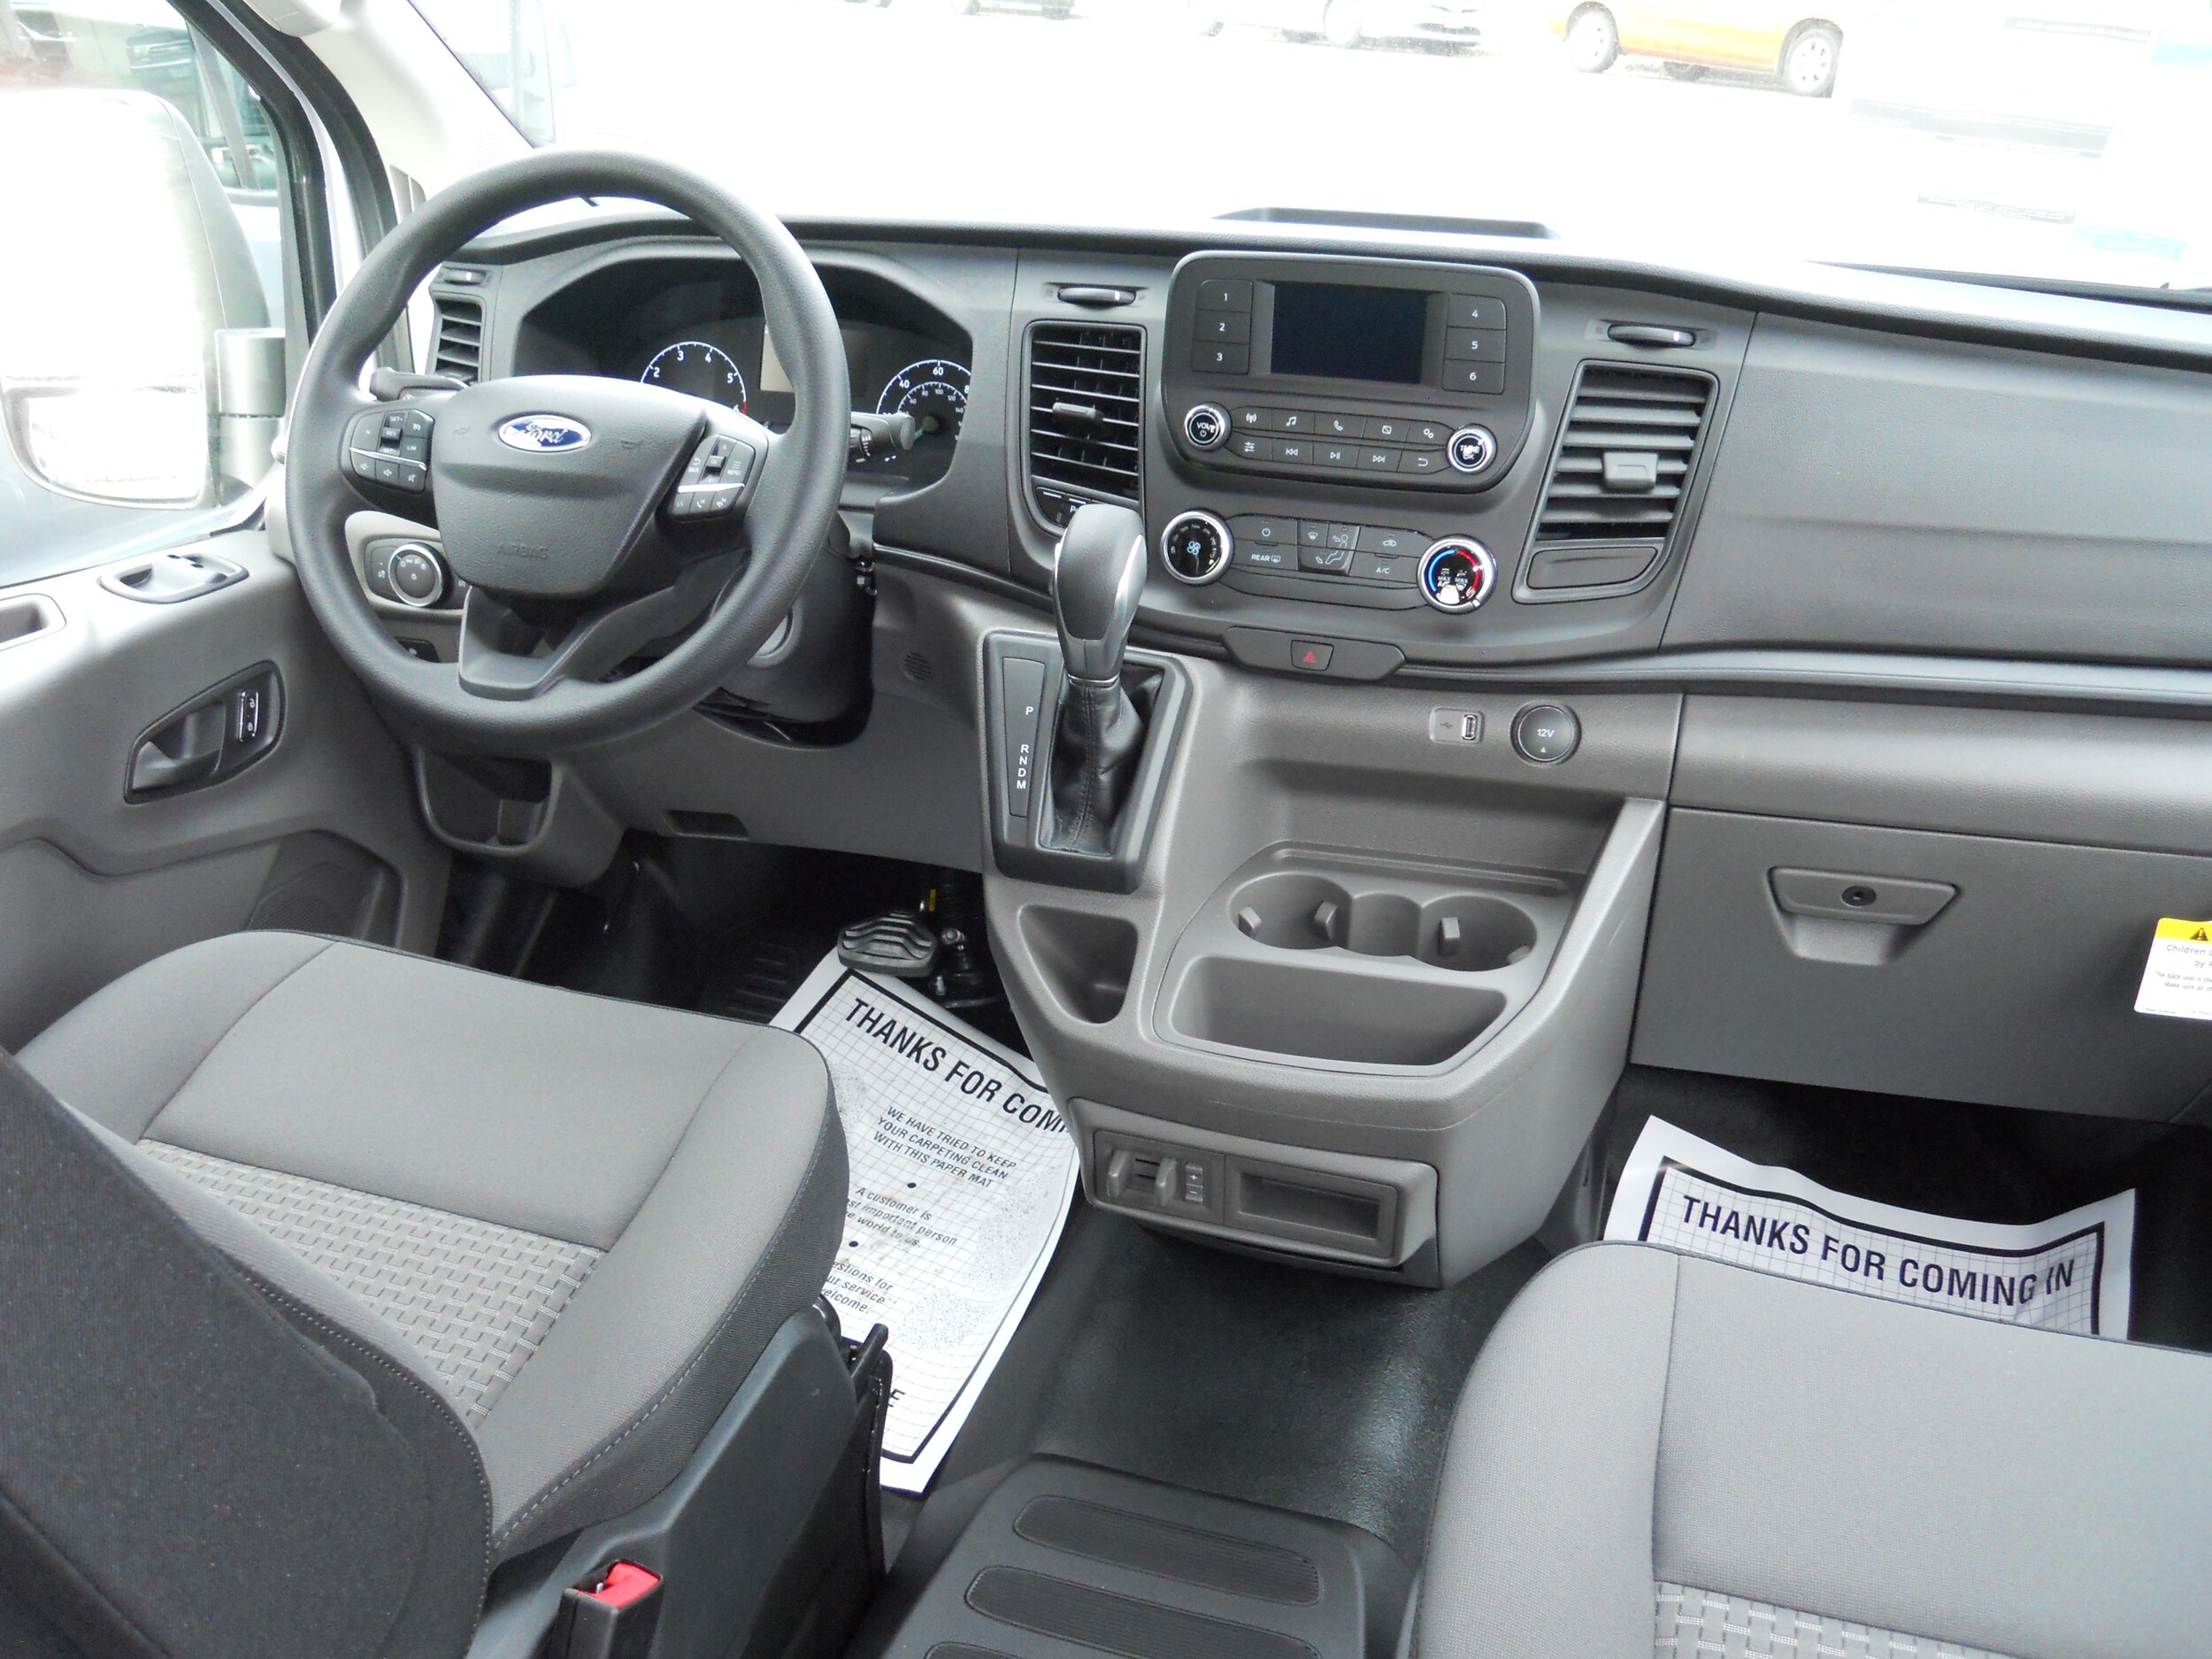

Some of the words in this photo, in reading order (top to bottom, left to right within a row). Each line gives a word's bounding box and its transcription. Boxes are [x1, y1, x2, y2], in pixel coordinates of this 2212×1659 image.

[1224, 292, 1228, 302] 1
[1471, 309, 1479, 319] 4
[1219, 322, 1225, 332] 2
[1471, 341, 1479, 349] 5
[677, 350, 684, 361] 3
[705, 352, 712, 363] 4
[1217, 352, 1223, 362] 3
[653, 366, 660, 378] 2
[933, 366, 944, 375] 60
[726, 373, 733, 384] 5
[1470, 372, 1477, 381] 6
[899, 380, 910, 388] 40
[1459, 444, 1480, 455] TE
[1025, 706, 1034, 715] P
[1537, 728, 1555, 738] 12V
[1020, 744, 1029, 753] R
[1019, 756, 1027, 765] N
[1018, 768, 1026, 777] D
[1017, 780, 1026, 789] M
[2166, 944, 2206, 955] Children
[844, 997, 947, 1071] THANKS
[944, 1059, 1002, 1103] FOR
[887, 1106, 906, 1123] WE
[905, 1117, 936, 1137] HAVE
[937, 1131, 970, 1150] TRIED
[972, 1145, 987, 1158] TO
[987, 1153, 1017, 1169] KEEP
[878, 1116, 909, 1140] YOUR
[909, 1133, 972, 1165] CARPETING
[971, 1160, 1009, 1179] CLEAN
[872, 1130, 903, 1153] WITH
[905, 1145, 931, 1164] THIS
[930, 1158, 968, 1179] PAPER
[967, 1173, 995, 1188] MAT
[856, 1187, 865, 1196] A
[866, 1192, 919, 1216] customer
[920, 1210, 933, 1222] is
[856, 1217, 891, 1234] world
[890, 1229, 902, 1240] to
[861, 1203, 918, 1231] important
[915, 1225, 957, 1246] person
[1683, 1194, 1810, 1255] THANKS
[1821, 1233, 1886, 1281] FOR
[1899, 1258, 2038, 1307] COMING
[2046, 1258, 2075, 1295] IN
[874, 1278, 894, 1292] for
[841, 1281, 886, 1304] service
[823, 1289, 869, 1314] elcome.
